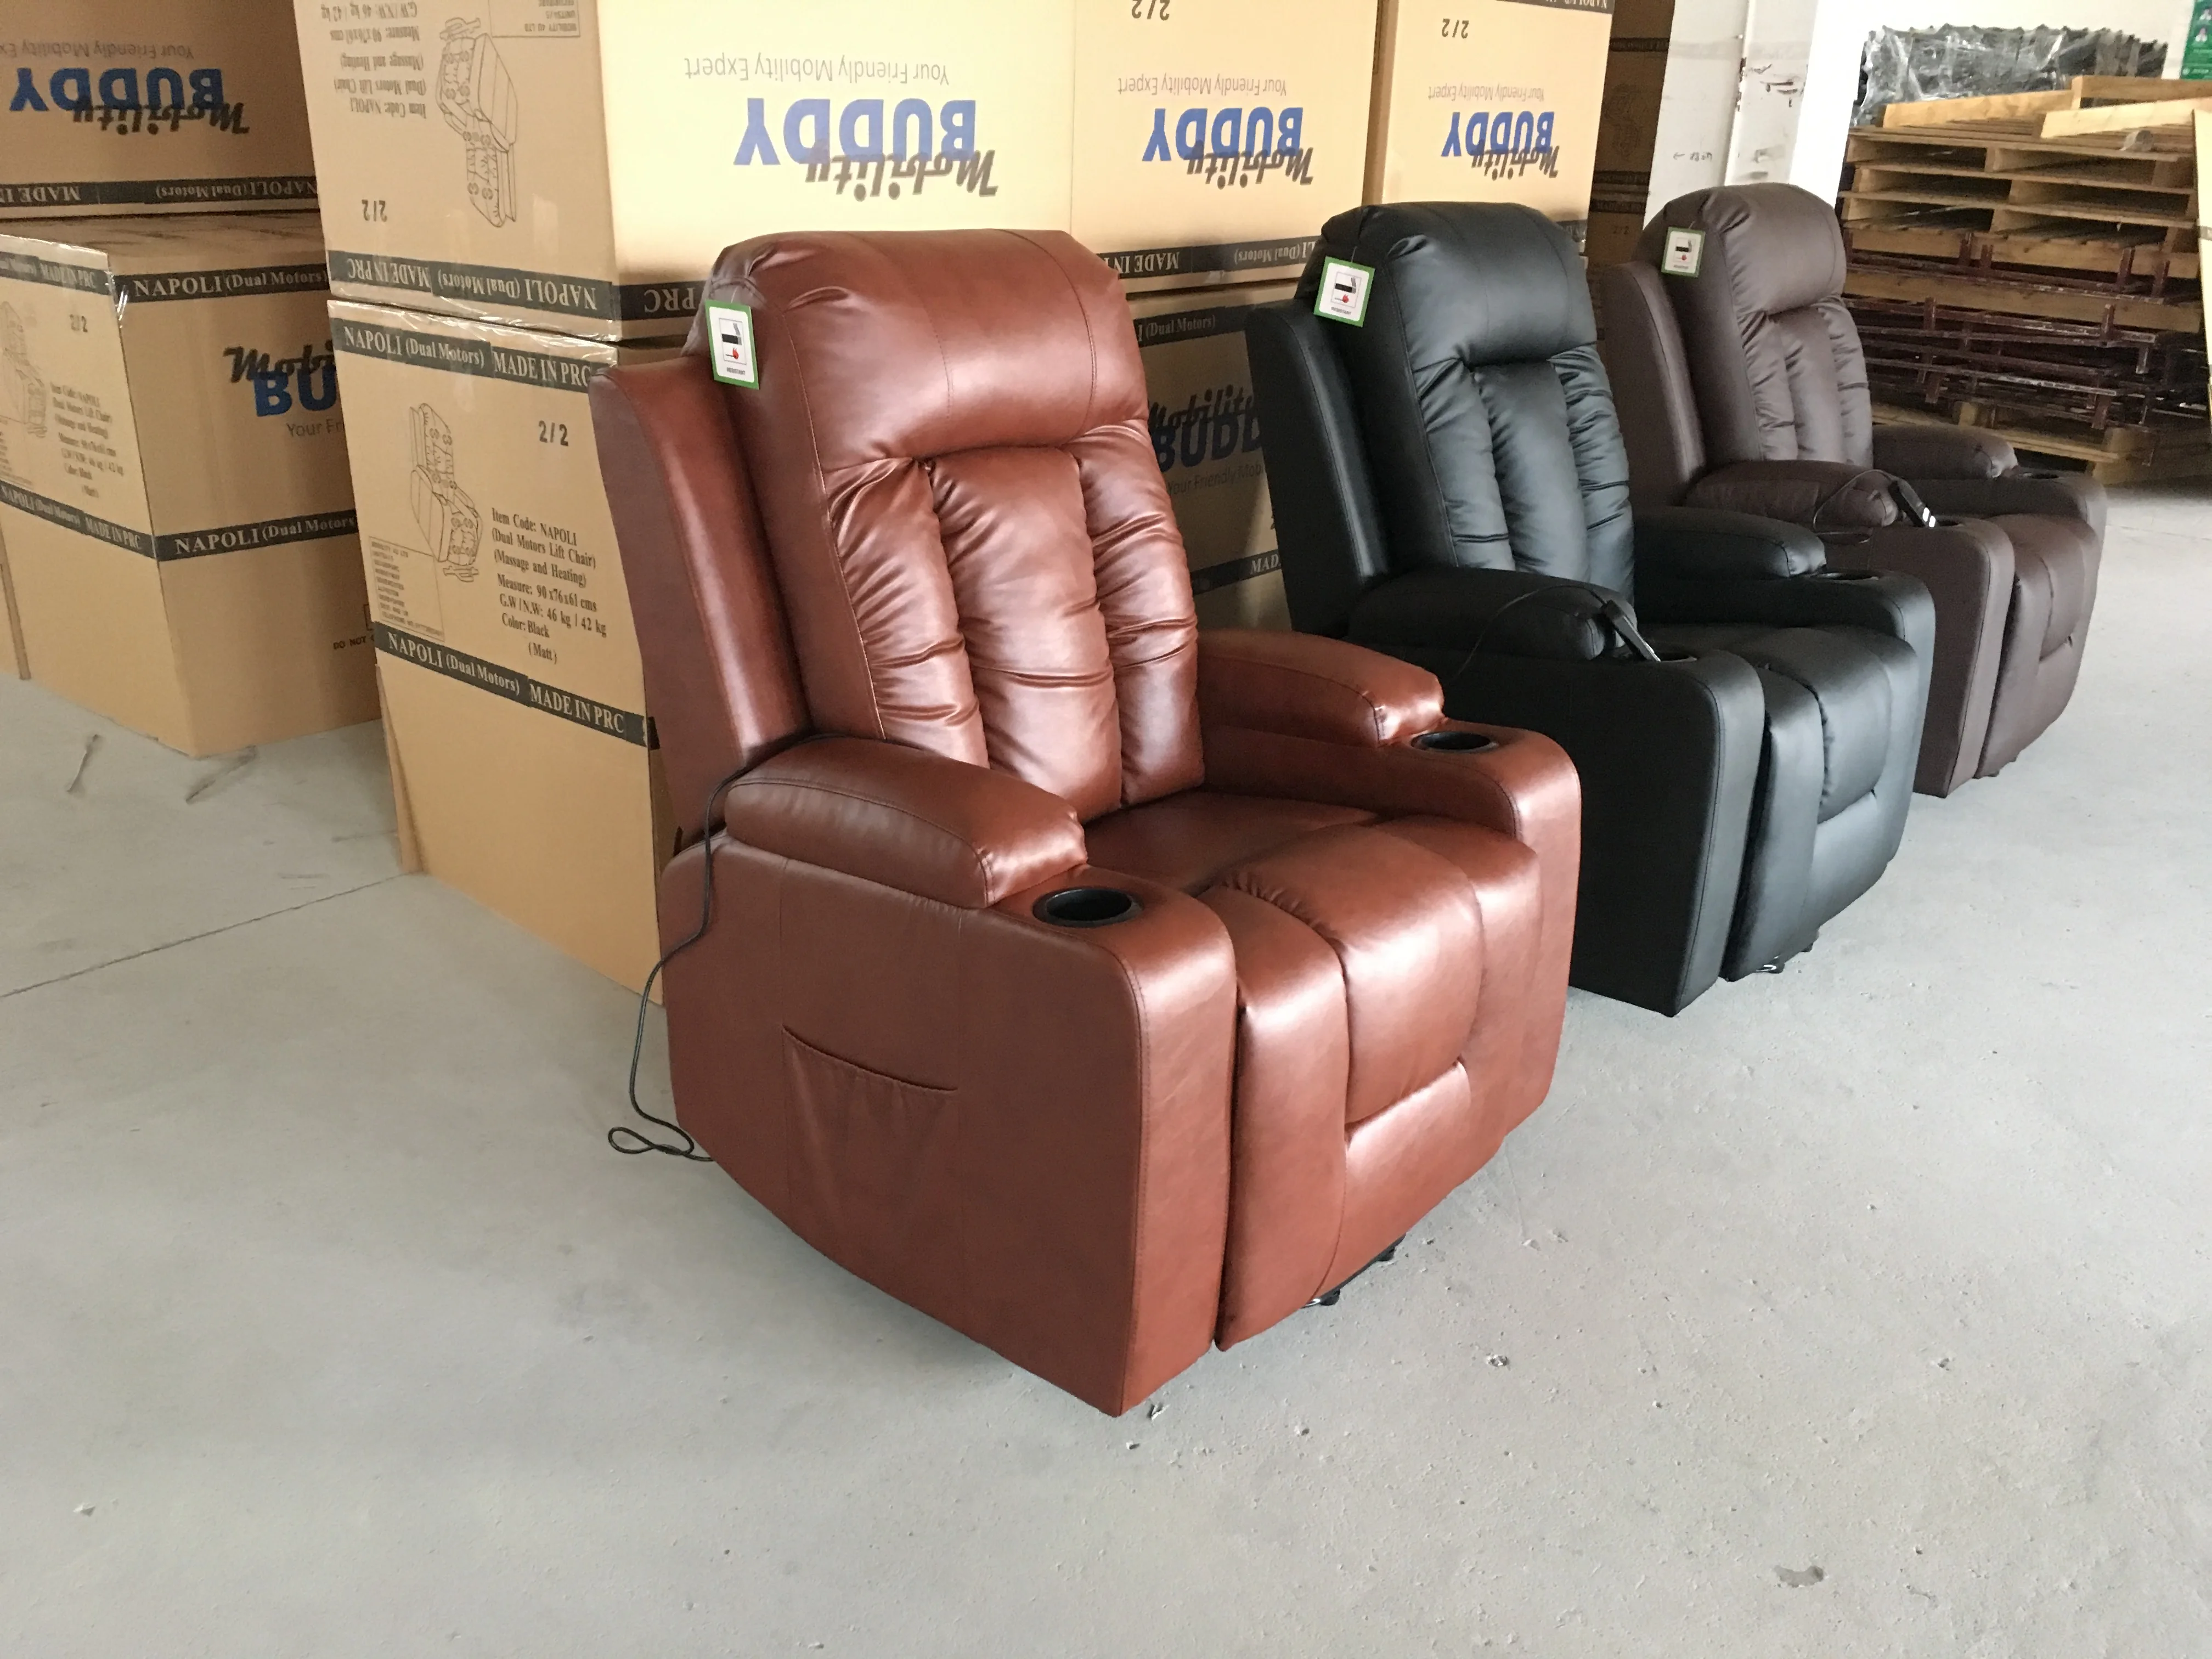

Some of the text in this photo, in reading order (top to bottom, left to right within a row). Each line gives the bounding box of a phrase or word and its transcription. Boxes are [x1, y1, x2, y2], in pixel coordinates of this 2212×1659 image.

[1441, 18, 1470, 39] 2/2
[684, 52, 950, 86] Your Friendly Mobility Expert
[1118, 72, 1287, 96] Your Friendly Mobility Expert
[9, 66, 225, 112] BUDDY
[1428, 83, 1457, 101] Expert
[1458, 82, 1493, 100] Mobility
[1495, 83, 1527, 102] Friendly
[70, 94, 251, 136] Mobility
[732, 97, 977, 166] BUDDY
[1141, 106, 1304, 162] BUDDY
[1441, 111, 1555, 157] BUDDY
[804, 138, 999, 202] Mobility
[1186, 139, 1314, 190] Mobility
[1471, 138, 1560, 181] Mobility
[18, 188, 82, 204] MADE
[1135, 251, 1181, 272] MADE
[1233, 245, 1272, 264] Motors)
[1273, 242, 1301, 261] (Dual
[132, 268, 328, 297] NAPOLI (Dual Motors)
[347, 258, 373, 280] PRC
[391, 262, 431, 290] MADE
[437, 269, 598, 311] NAPOLI (Dual Motors)
[644, 287, 697, 313] PRC
[1145, 318, 1175, 341] (Dual
[1176, 314, 1216, 333] Motors)
[223, 339, 335, 383] Mobi
[343, 325, 484, 369] NAPOLI (Dual Motors)
[493, 351, 591, 387] MADE IN PRC
[285, 422, 322, 437] Your
[538, 420, 569, 447] 2/2
[1152, 409, 1263, 473] BUDD
[84, 516, 140, 550] MADE IN PRC
[174, 516, 357, 555] NAPOLI (Dual Motors
[492, 507, 578, 547] Item Code: NAPOLI
[492, 527, 596, 571] (Dual Motors Lift Chair)
[1250, 553, 1282, 575] MAD
[494, 548, 586, 589] (Massage and Heating)
[496, 572, 533, 595] Measure:
[580, 598, 597, 613] cms
[501, 612, 550, 639] Color: Black
[546, 607, 558, 622] 46
[560, 610, 572, 629] kg
[580, 616, 592, 631] 42
[595, 618, 607, 638] kg
[332, 640, 346, 650] DO
[348, 635, 366, 647] NOT
[386, 631, 521, 697] NAPOLI (Dual Motors)
[529, 683, 625, 734] MADE IN PRC
